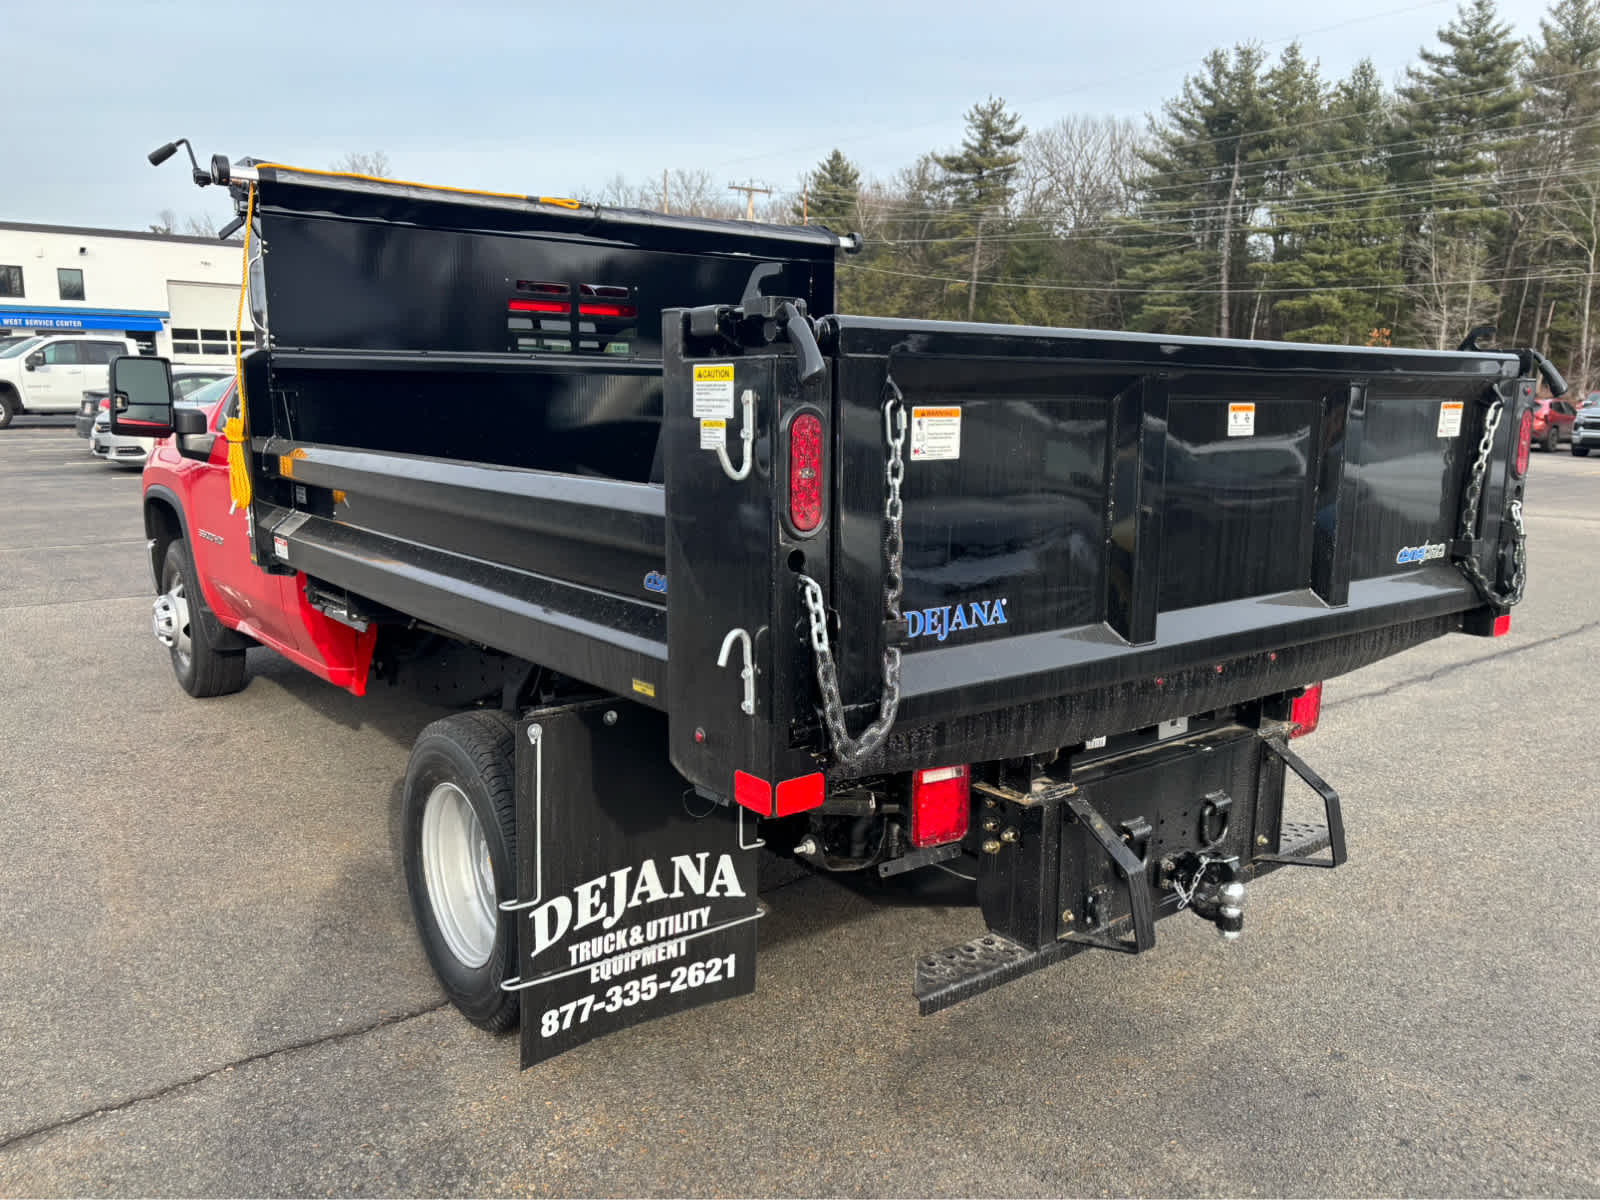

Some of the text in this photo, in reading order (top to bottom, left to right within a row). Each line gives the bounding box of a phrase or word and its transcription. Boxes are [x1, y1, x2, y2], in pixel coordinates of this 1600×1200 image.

[3, 318, 82, 328] WEST SERVICE CENTER
[702, 368, 730, 378] CAUTION
[903, 598, 1007, 641] DEJANA
[528, 852, 746, 958] DEJANA
[568, 928, 629, 966] TRUCK
[646, 906, 711, 941] UTILITY
[590, 939, 687, 984] EQUIPMENT
[540, 953, 736, 1038] 877-335-2621
